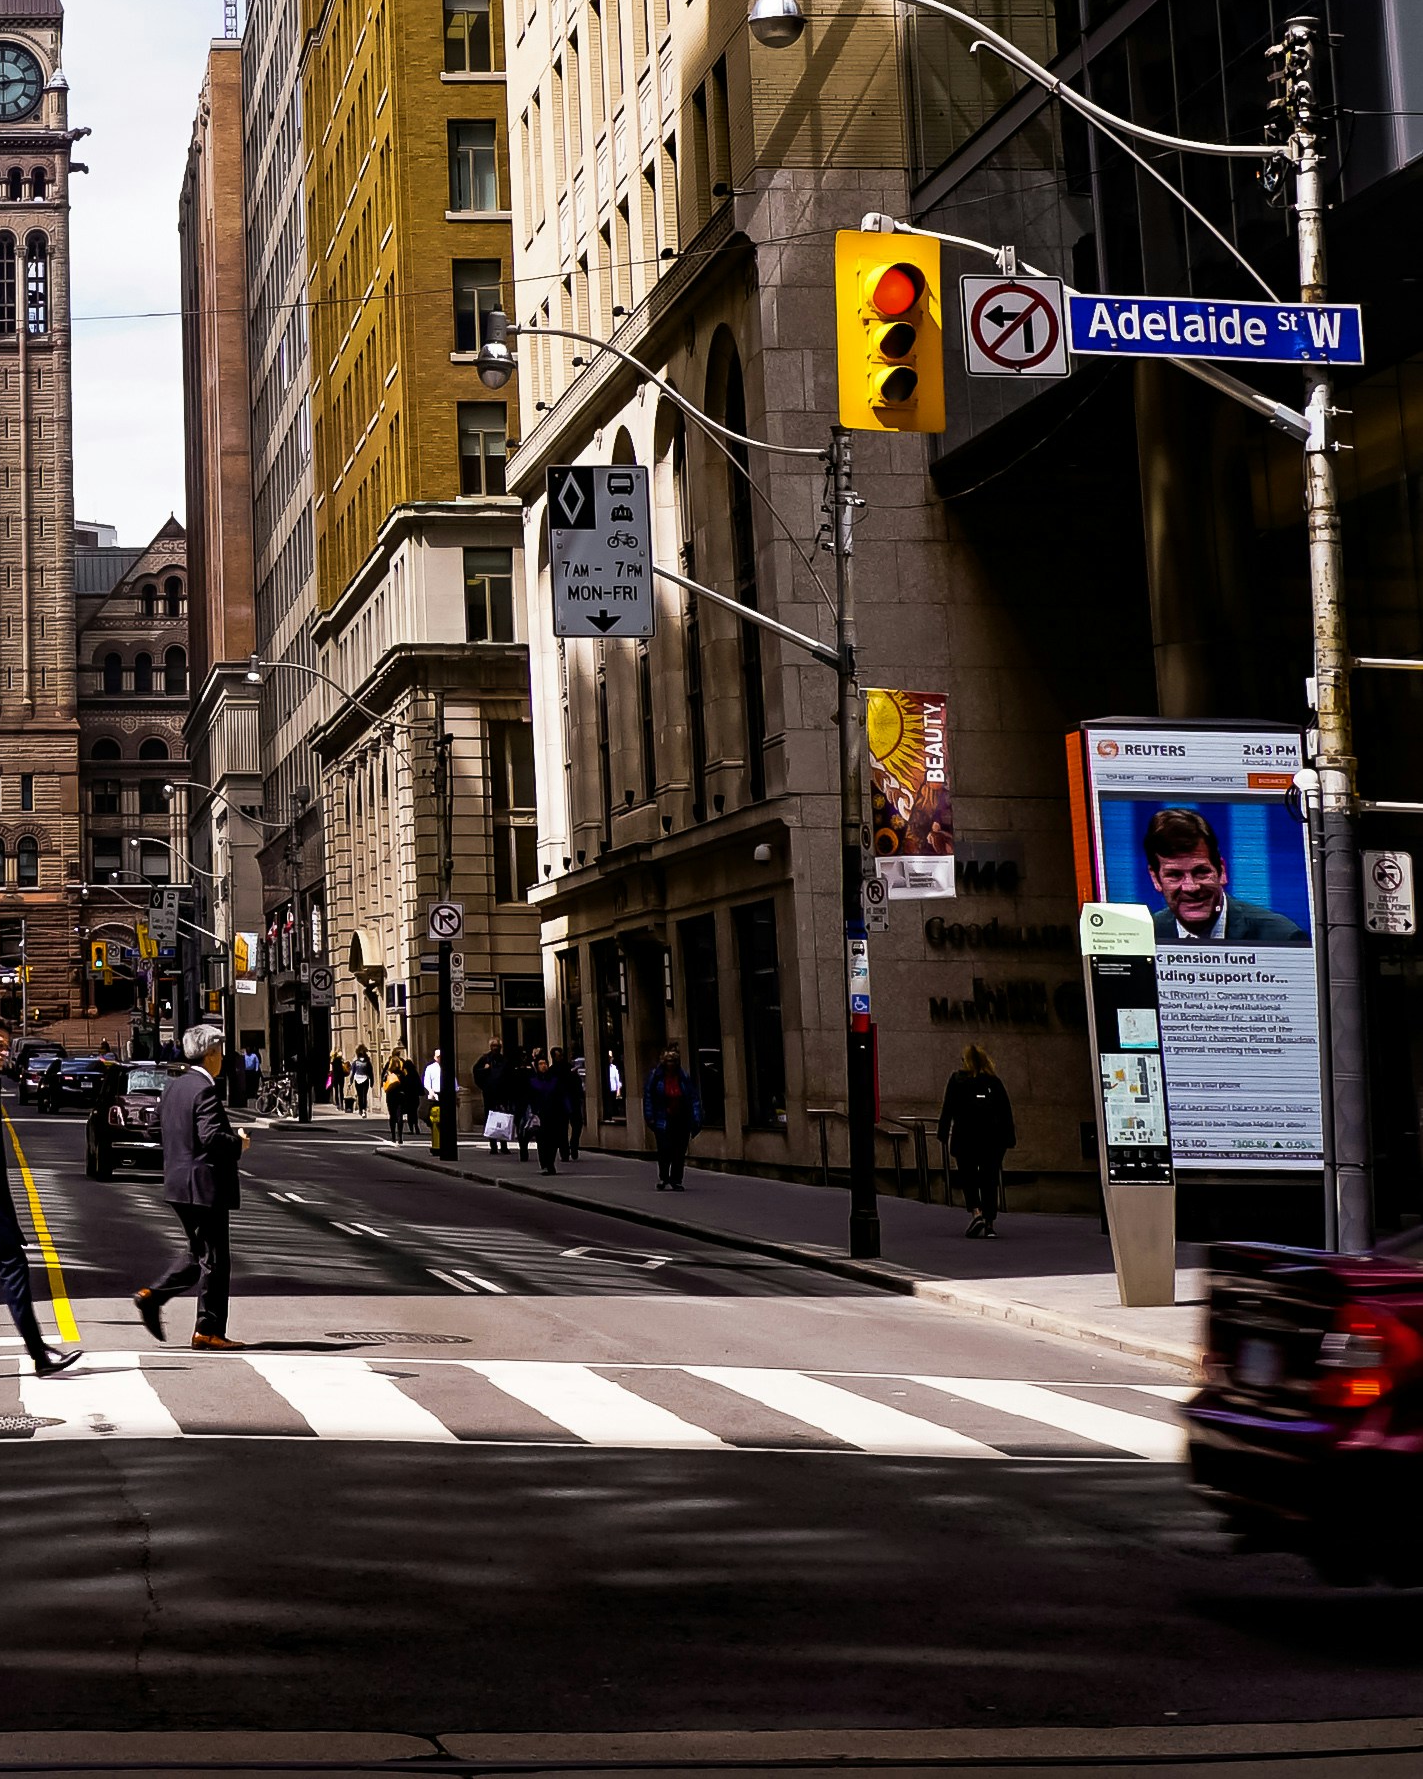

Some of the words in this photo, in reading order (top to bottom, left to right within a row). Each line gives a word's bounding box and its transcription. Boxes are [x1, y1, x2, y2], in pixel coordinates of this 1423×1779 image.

[1088, 301, 1268, 347] Adelaide
[1276, 311, 1299, 333] St
[1306, 311, 1342, 350] W
[566, 584, 639, 602] MON-FRI
[923, 701, 946, 784] BEAUTY.
[1124, 743, 1186, 757] REUTERS
[1242, 744, 1273, 757] 2:43
[1275, 745, 1297, 757] PM
[1167, 953, 1221, 966] pension
[1224, 952, 1256, 965] fund
[1199, 971, 1253, 985] support
[1191, 1139, 1208, 1148] 100
